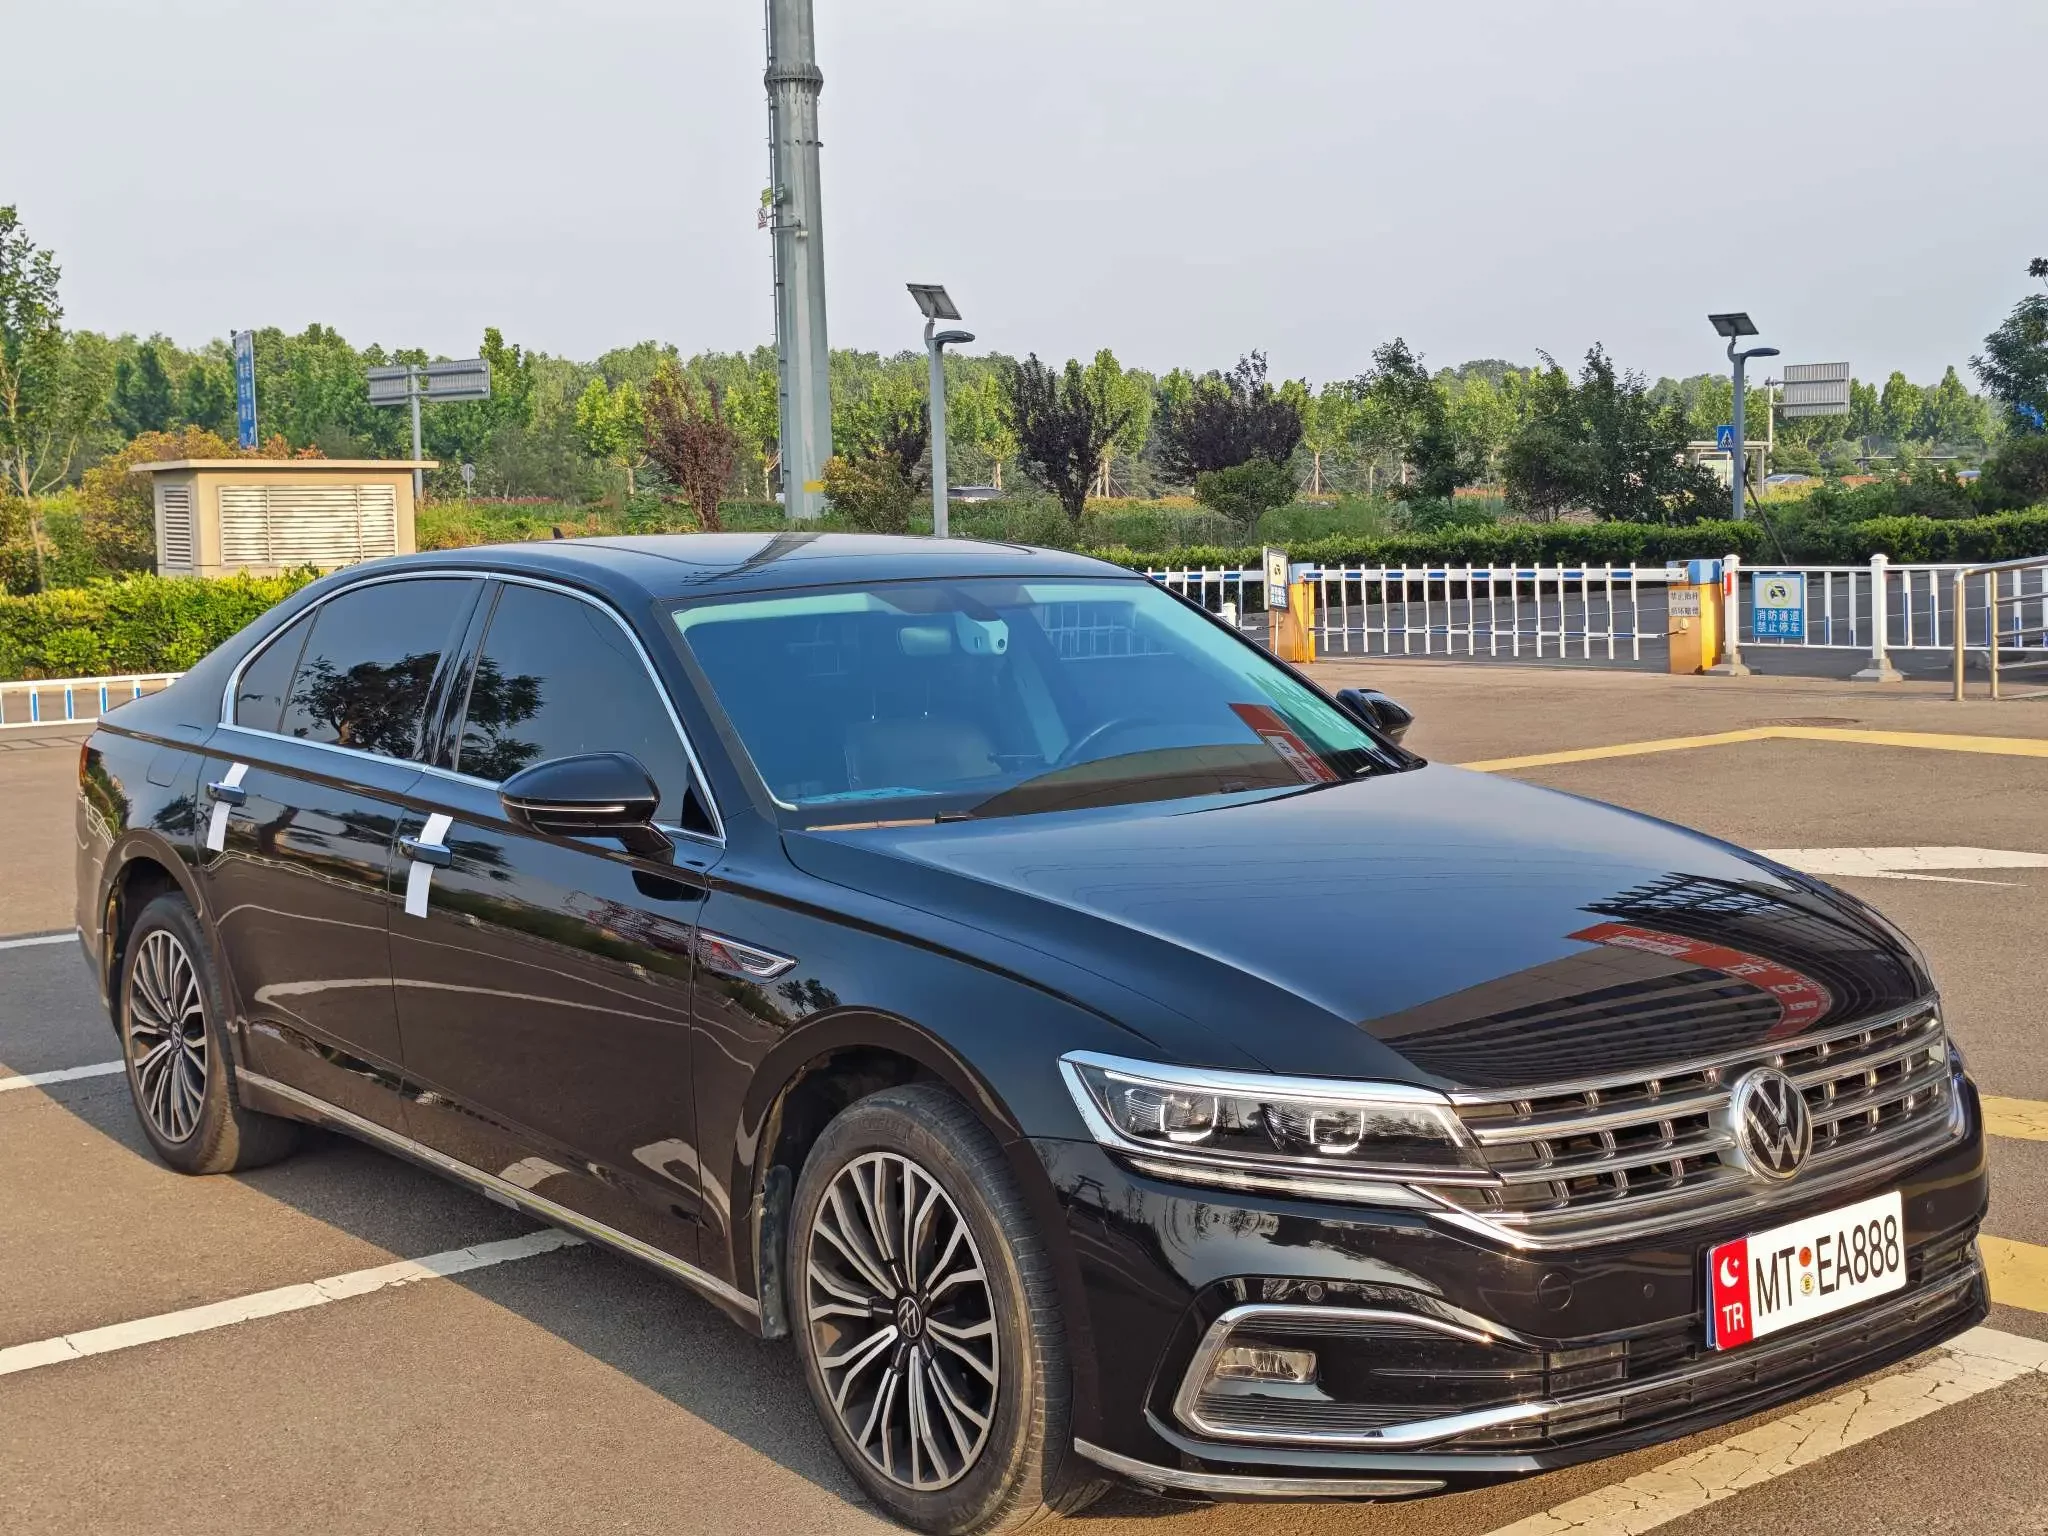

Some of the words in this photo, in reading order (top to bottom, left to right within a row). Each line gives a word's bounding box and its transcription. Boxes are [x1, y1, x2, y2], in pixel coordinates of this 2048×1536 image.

[1757, 609, 1800, 621] 消防通道
[1757, 621, 1800, 633] 禁止停车
[1755, 1245, 1796, 1317] MT
[1815, 1214, 1900, 1296] EA888
[1722, 1302, 1745, 1334] TR
